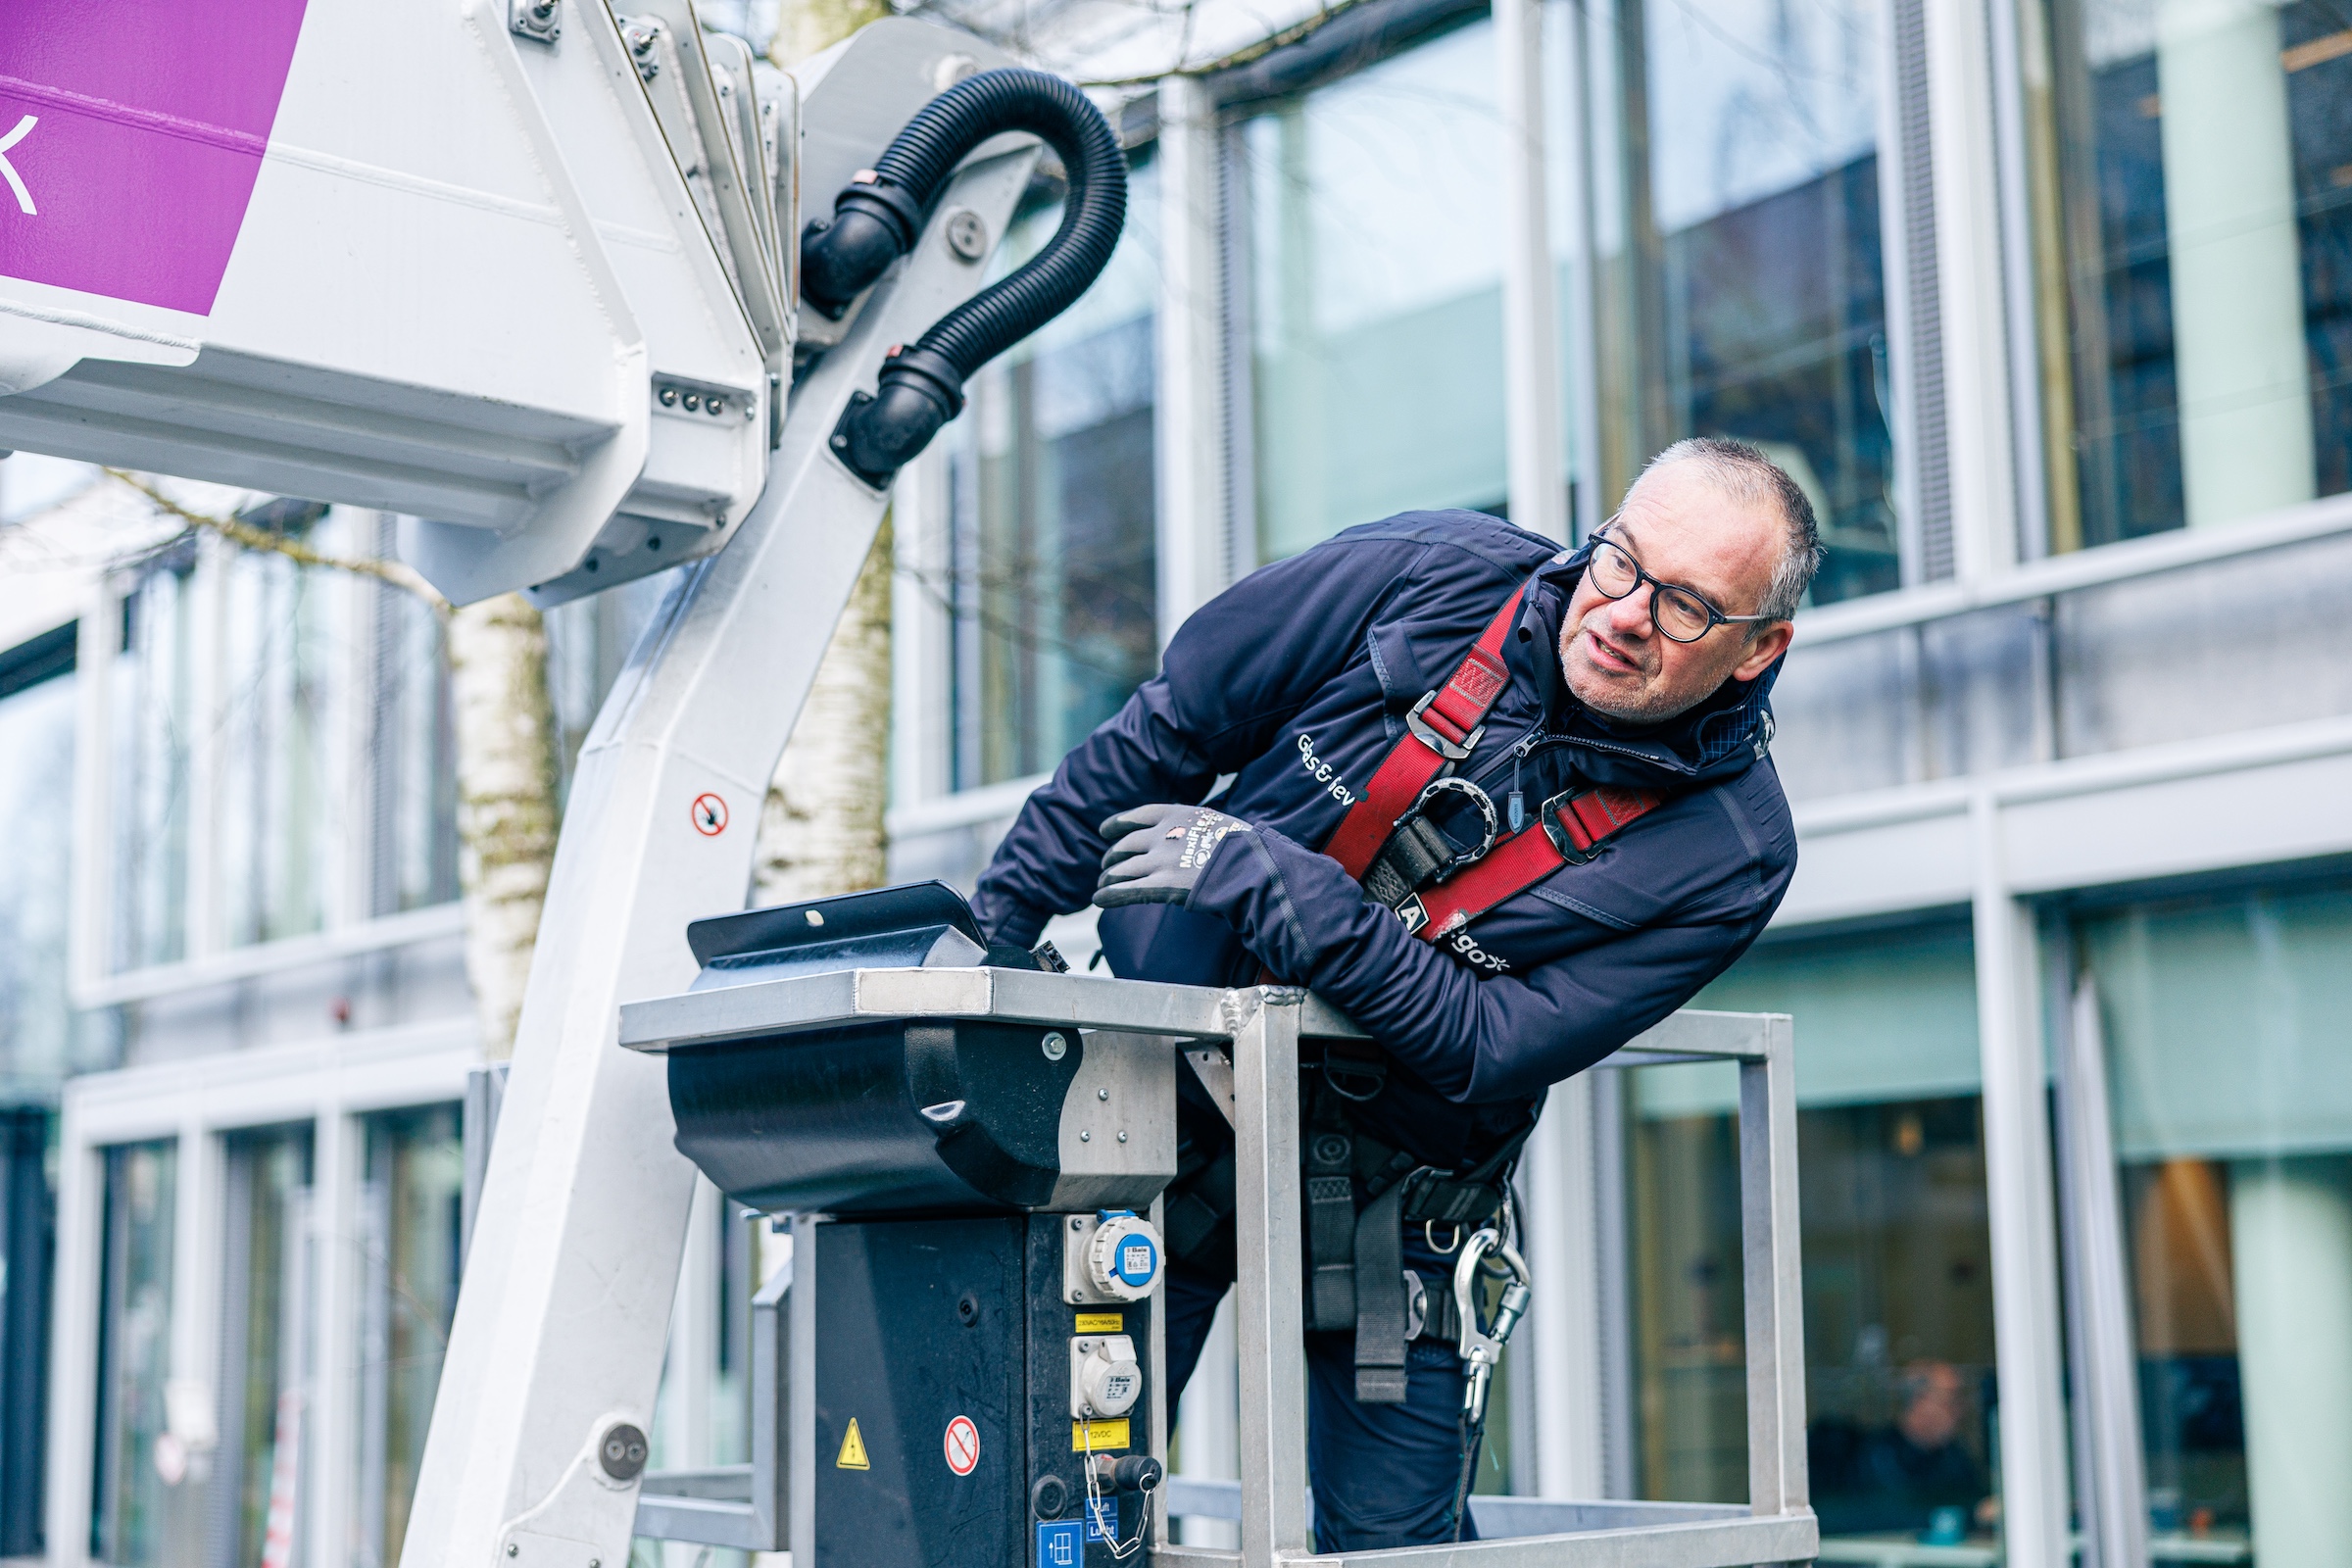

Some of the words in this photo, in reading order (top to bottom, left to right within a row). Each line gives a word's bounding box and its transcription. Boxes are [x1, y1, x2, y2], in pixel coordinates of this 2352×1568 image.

[1315, 763, 1333, 783] &
[1179, 812, 1208, 868] MaxiFlex
[1089, 1524, 1115, 1538] Luht
